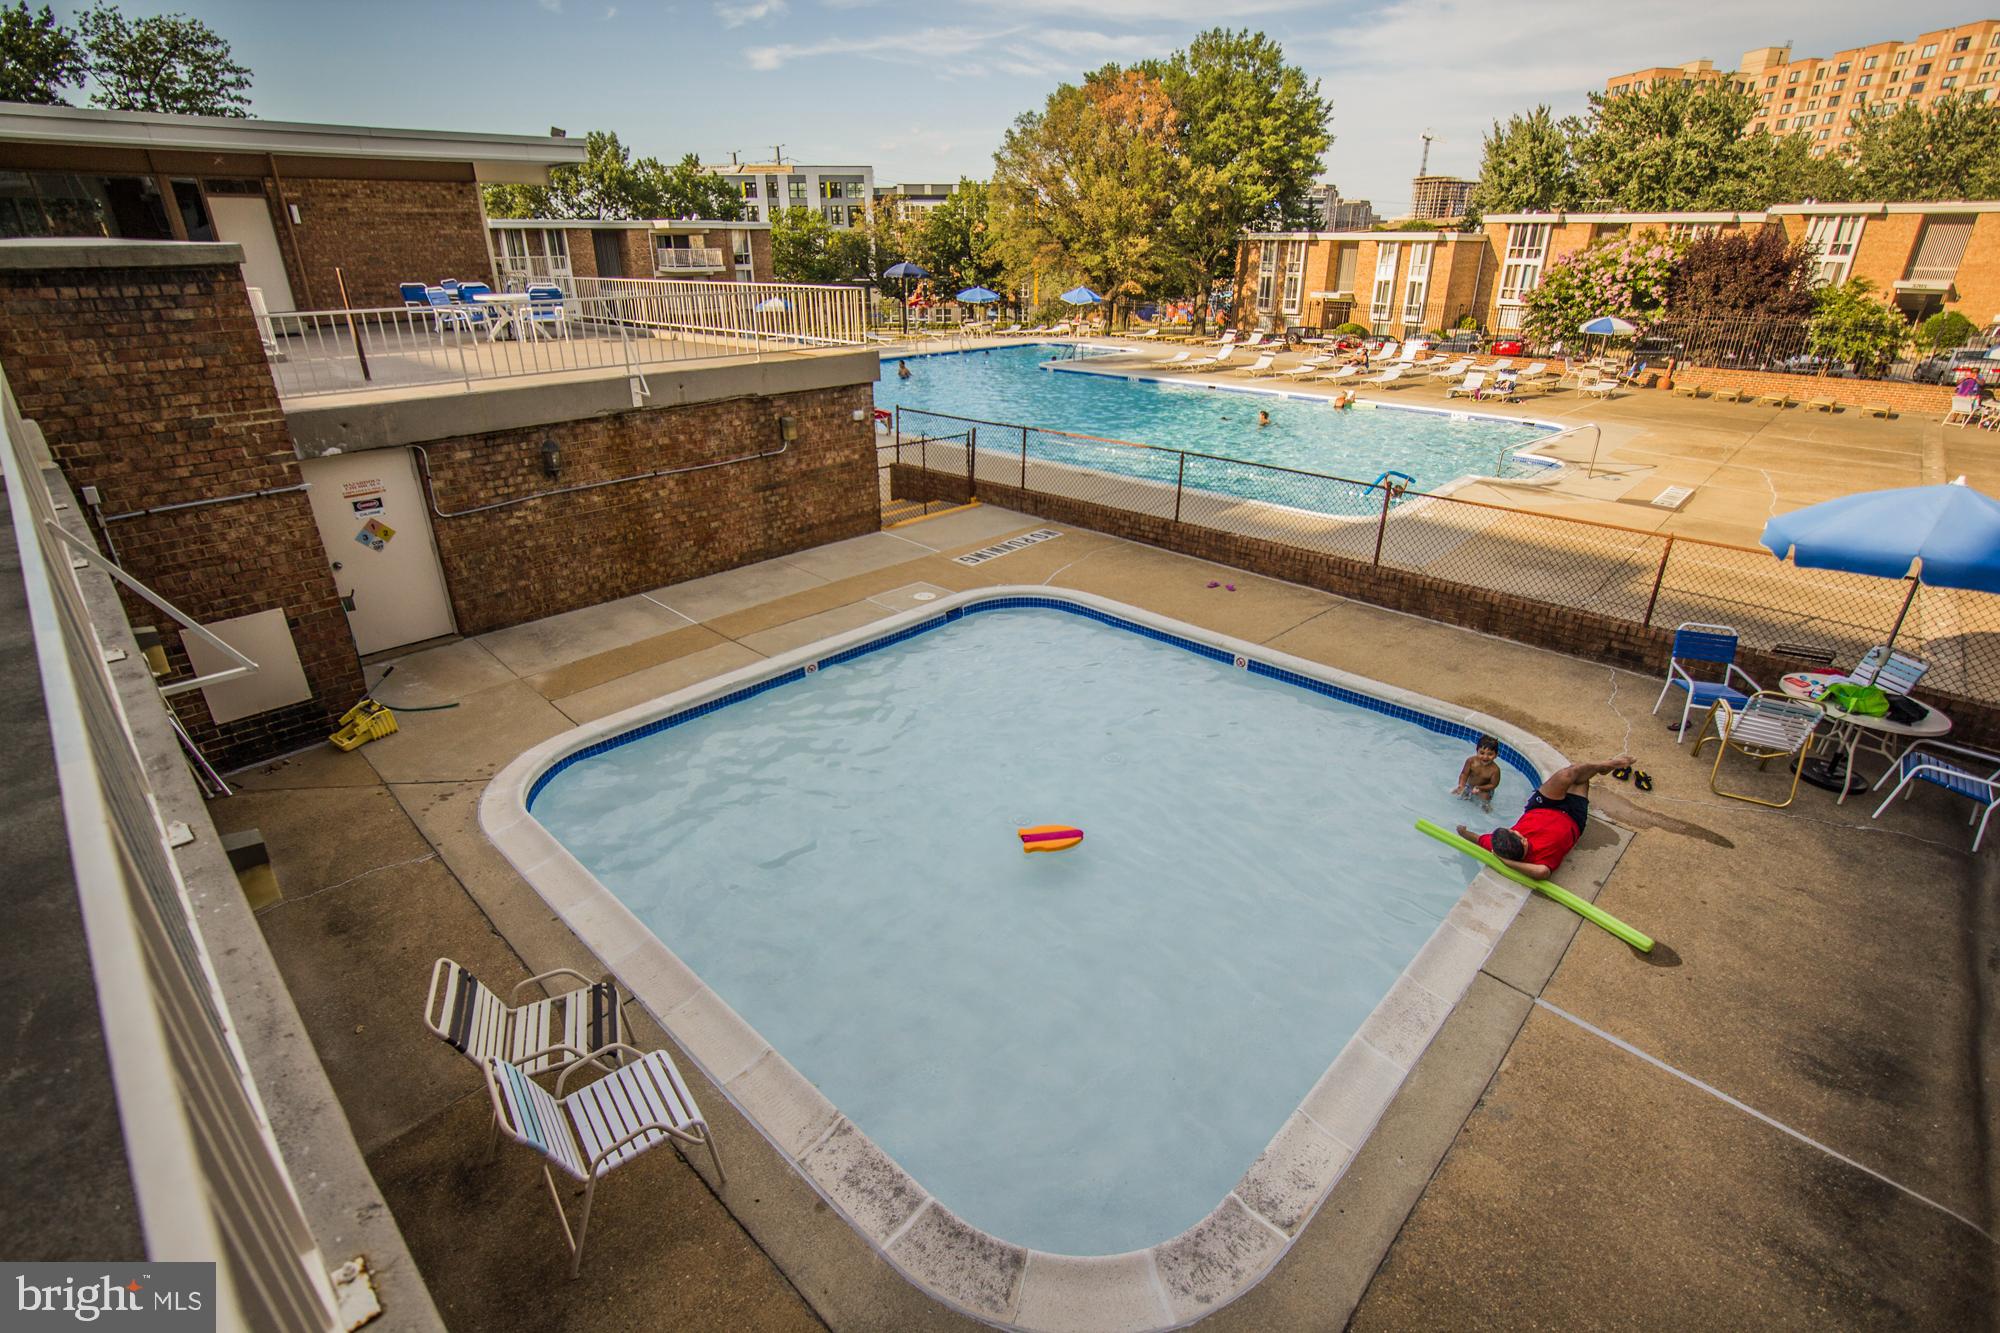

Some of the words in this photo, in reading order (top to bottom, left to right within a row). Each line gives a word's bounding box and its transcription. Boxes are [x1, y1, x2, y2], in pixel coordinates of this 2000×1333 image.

[383, 529, 389, 537] 2
[1030, 530, 1059, 539] NO
[959, 537, 1037, 564] RUNNING
